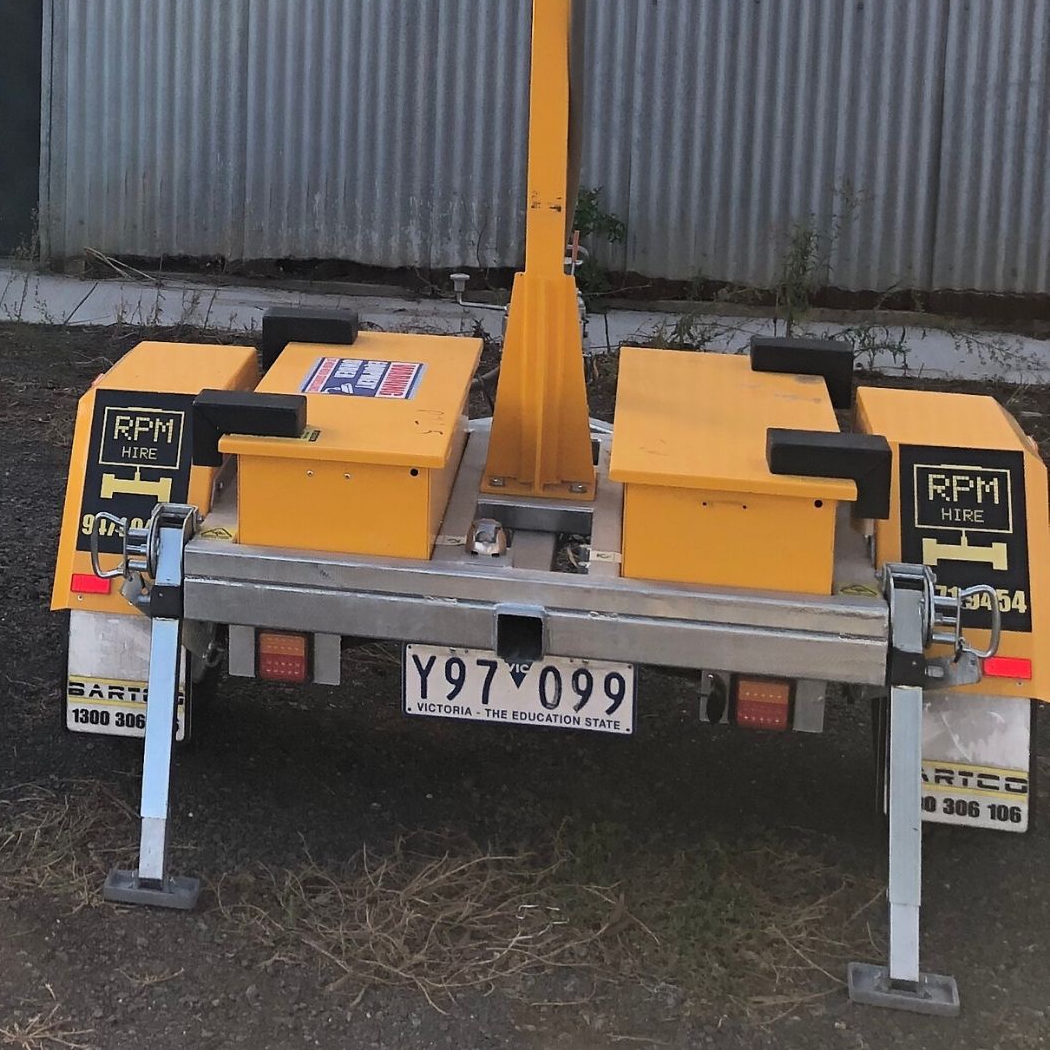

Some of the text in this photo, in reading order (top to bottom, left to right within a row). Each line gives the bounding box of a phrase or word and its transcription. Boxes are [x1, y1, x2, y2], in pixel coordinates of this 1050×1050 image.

[113, 415, 174, 443] RPM
[121, 445, 158, 460] HIRE
[928, 473, 1000, 504] RPM
[941, 507, 985, 523] HIRE
[507, 663, 531, 673] VIC
[68, 681, 148, 703] BART
[412, 654, 626, 716] Y97 099
[72, 708, 146, 729] 1300 306
[417, 702, 472, 717] VICTORIA
[485, 708, 509, 720] THE
[512, 710, 581, 727] EDUCATION
[584, 717, 622, 730] STATE
[921, 766, 1028, 794] RTCO
[943, 798, 980, 818] 306
[987, 803, 1022, 824] 106
